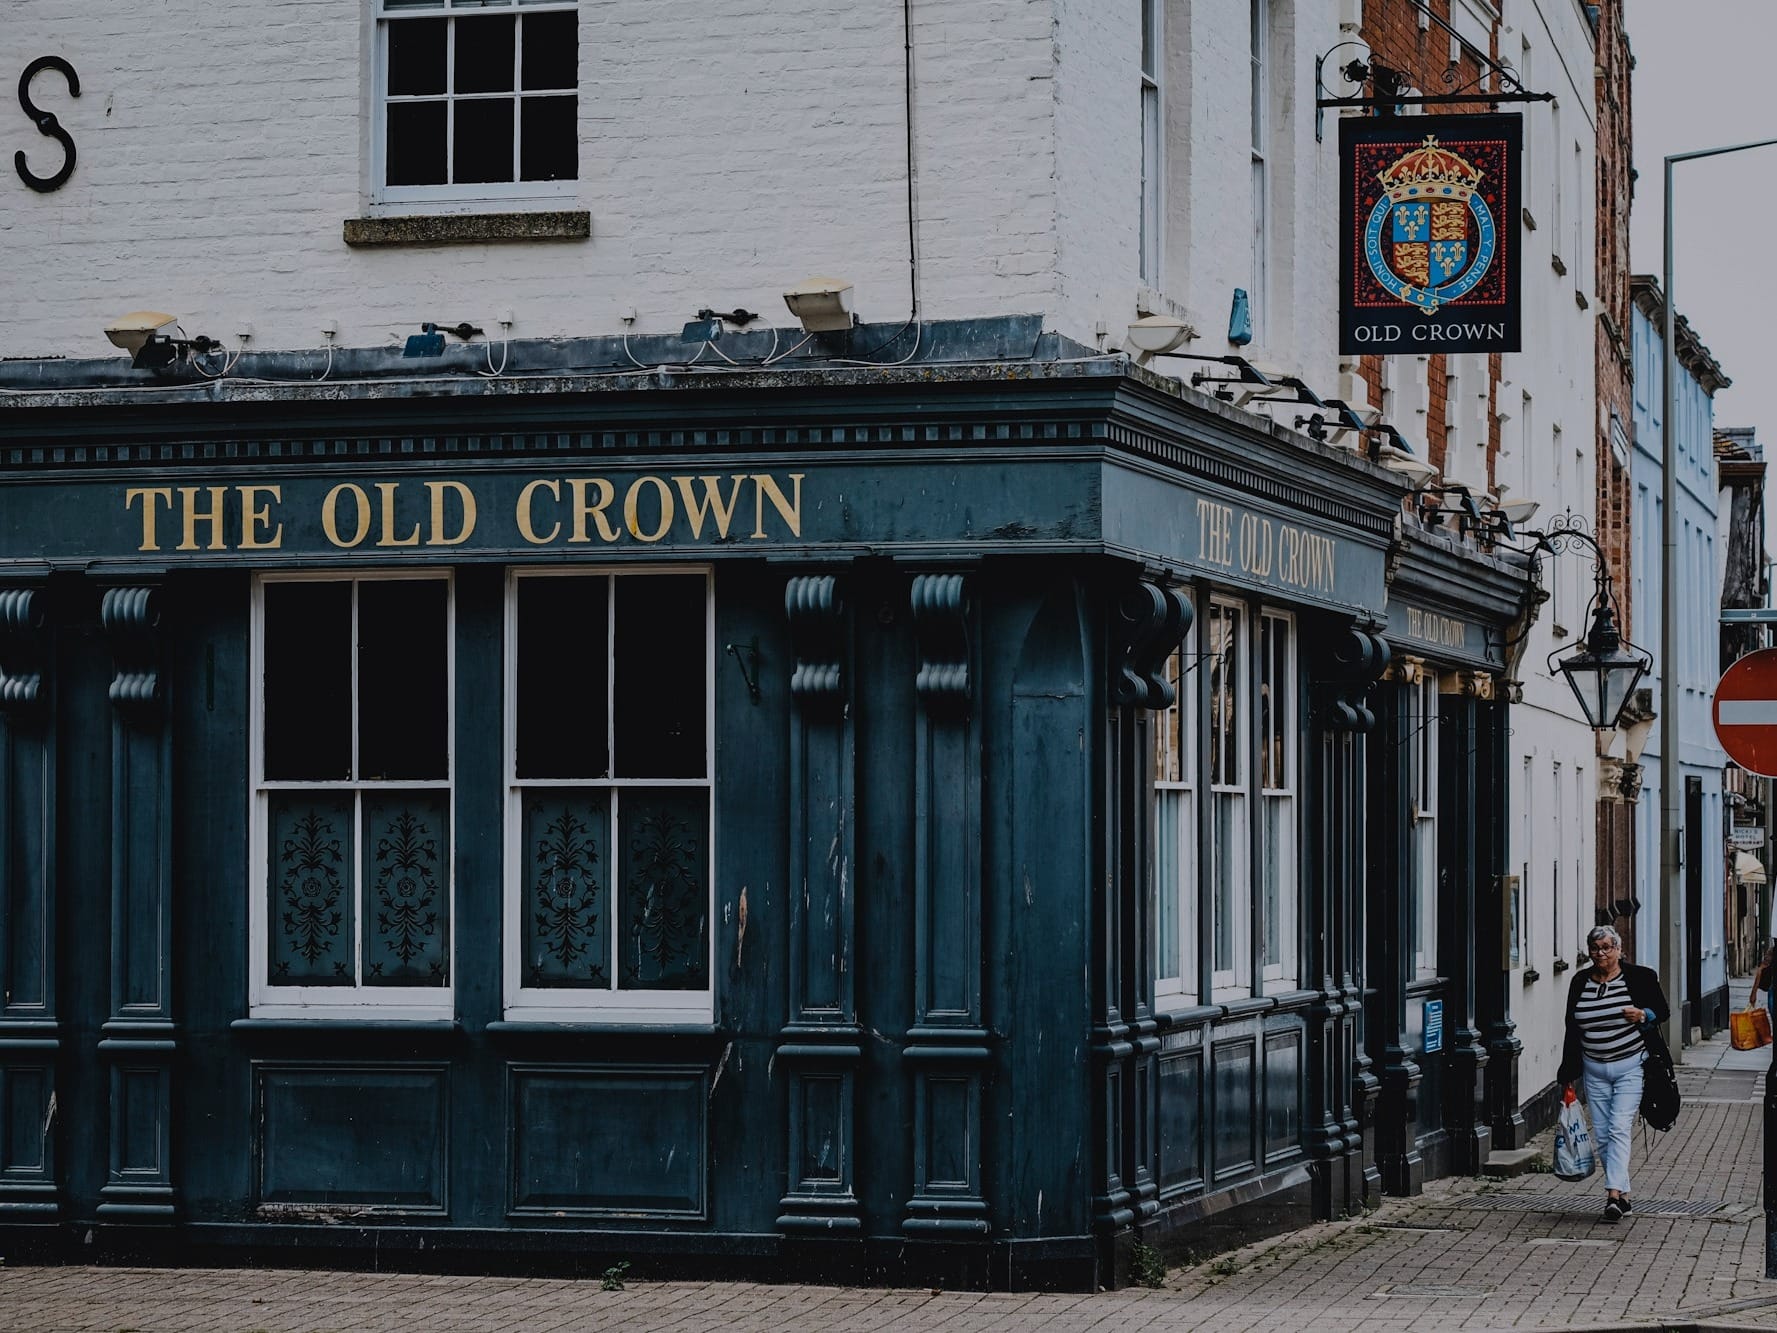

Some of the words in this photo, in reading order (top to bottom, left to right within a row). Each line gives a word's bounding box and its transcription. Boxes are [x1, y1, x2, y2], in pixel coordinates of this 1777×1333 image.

[1371, 204, 1388, 224] QUI
[1475, 205, 1490, 232] MAL
[1367, 229, 1378, 256] SOIT
[1484, 239, 1492, 248] Y
[1373, 259, 1396, 289] HONI
[1460, 256, 1489, 292] PENSE
[1354, 325, 1401, 342] OLD
[1411, 323, 1505, 341] CROWN
[125, 485, 283, 551] THE
[321, 481, 477, 548] OLD
[515, 473, 806, 544] CROWN
[1196, 499, 1233, 567] THE
[1240, 512, 1272, 577] OLD
[1278, 524, 1336, 592] CROWN
[1407, 607, 1422, 638] THE
[1424, 612, 1439, 642] OLD
[1440, 617, 1464, 648] CROWN
